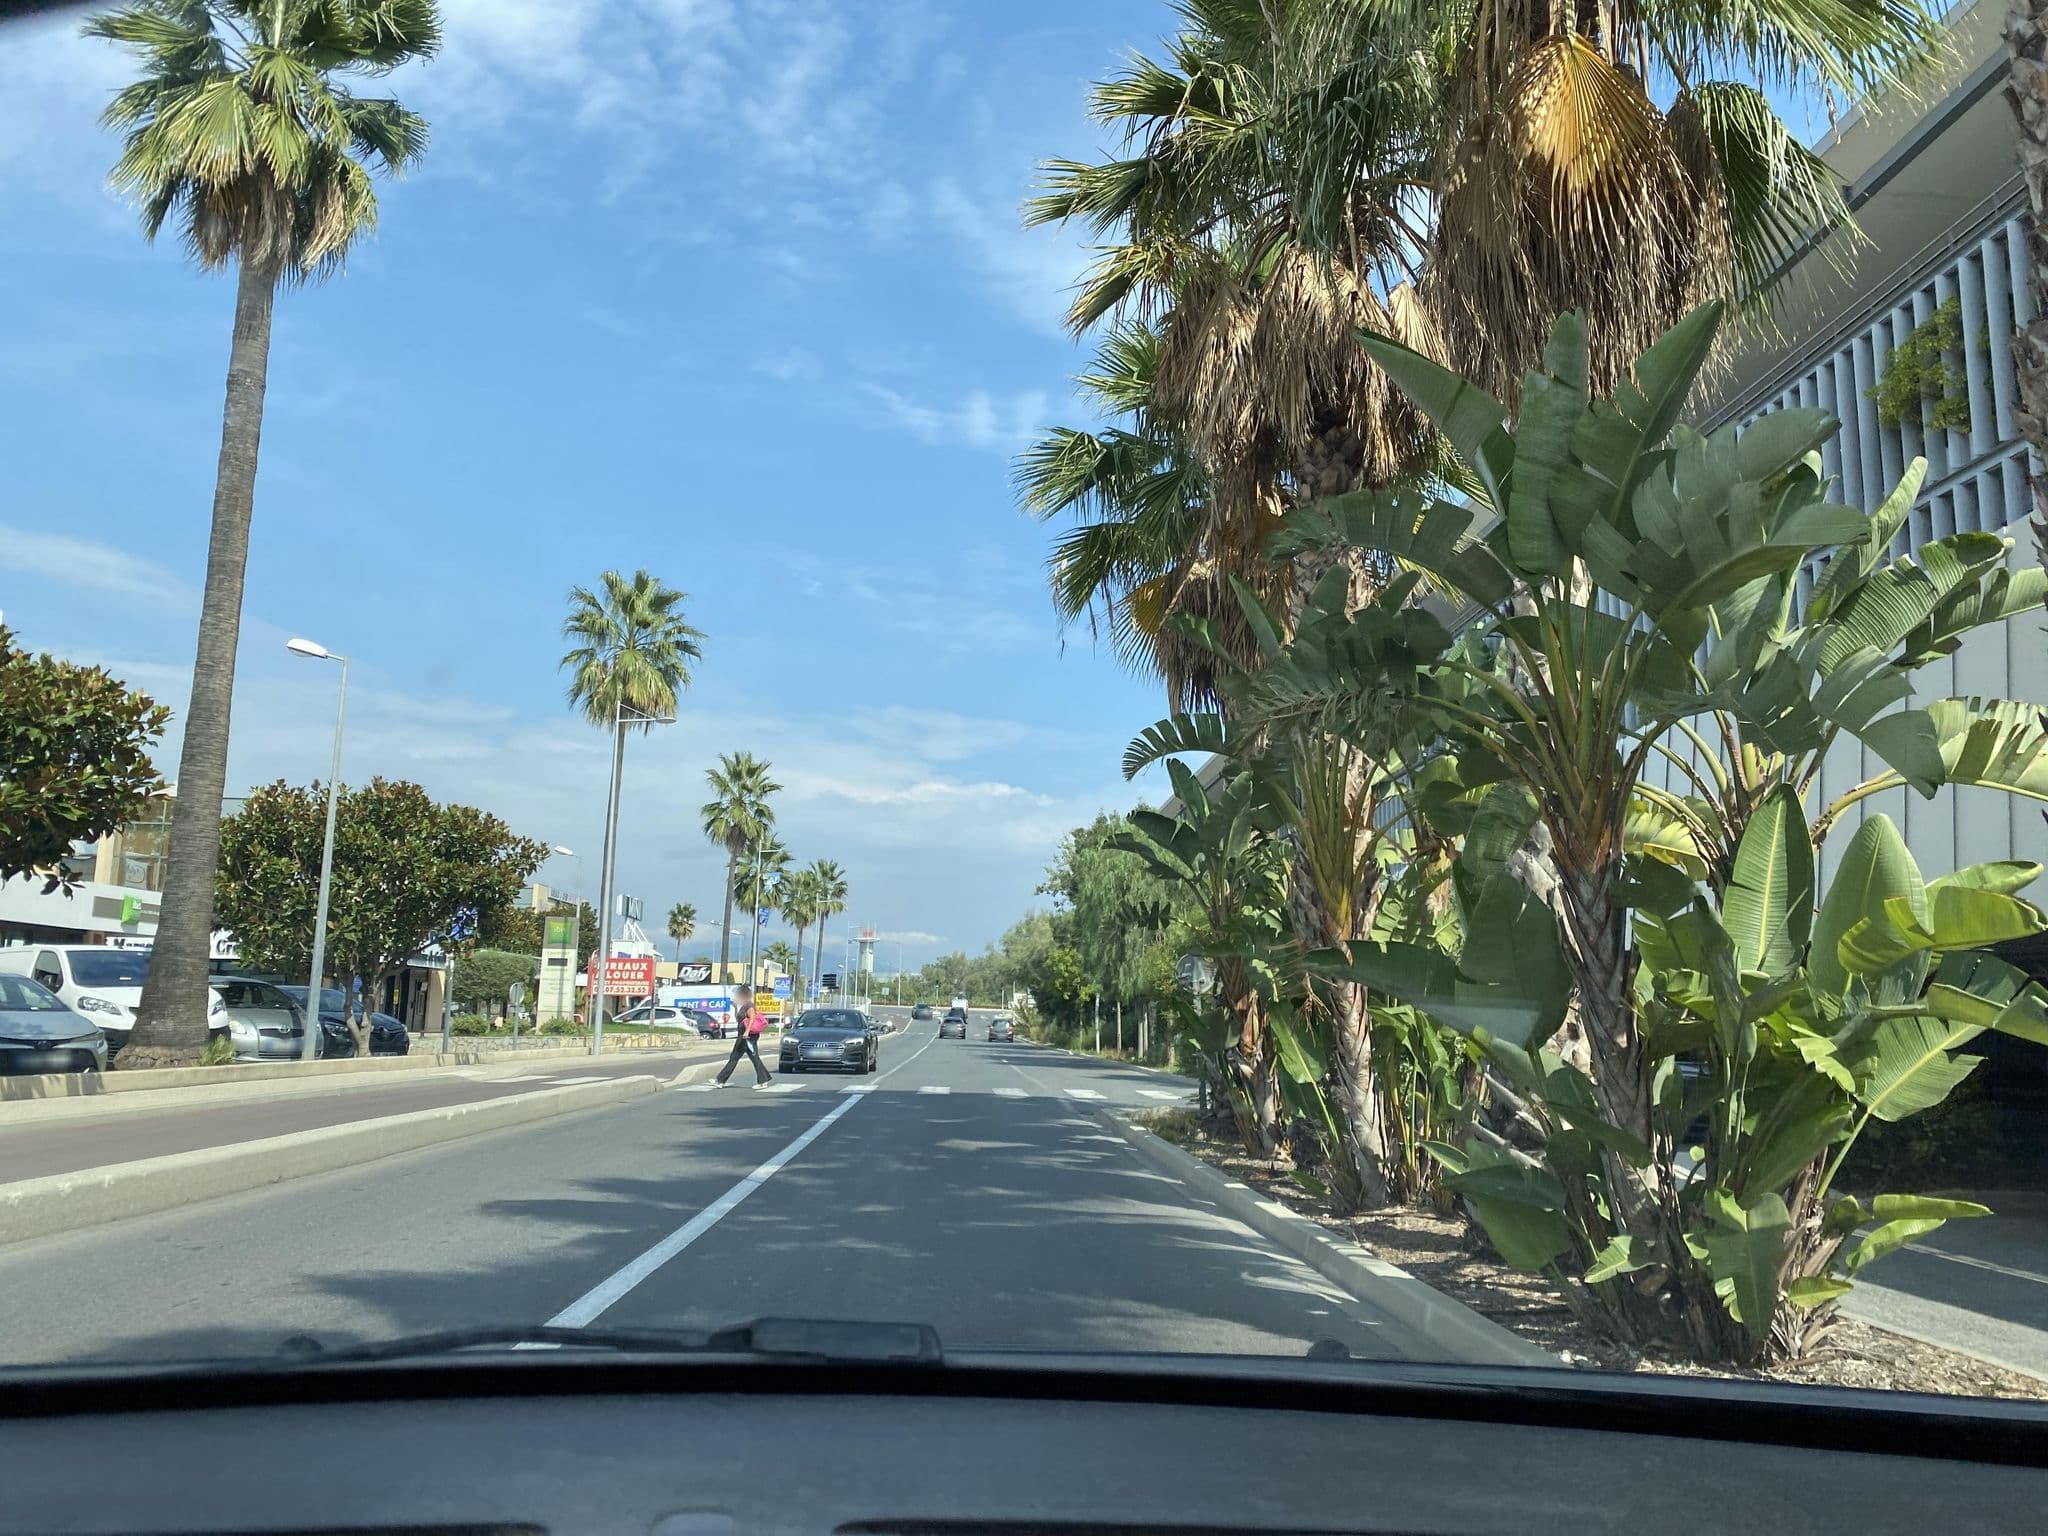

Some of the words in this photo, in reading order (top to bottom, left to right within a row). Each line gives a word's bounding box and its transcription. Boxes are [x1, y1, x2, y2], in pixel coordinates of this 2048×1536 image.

[606, 971, 644, 980] LOUER
[679, 966, 711, 982] Dafy
[708, 1000, 727, 1009] CAR
